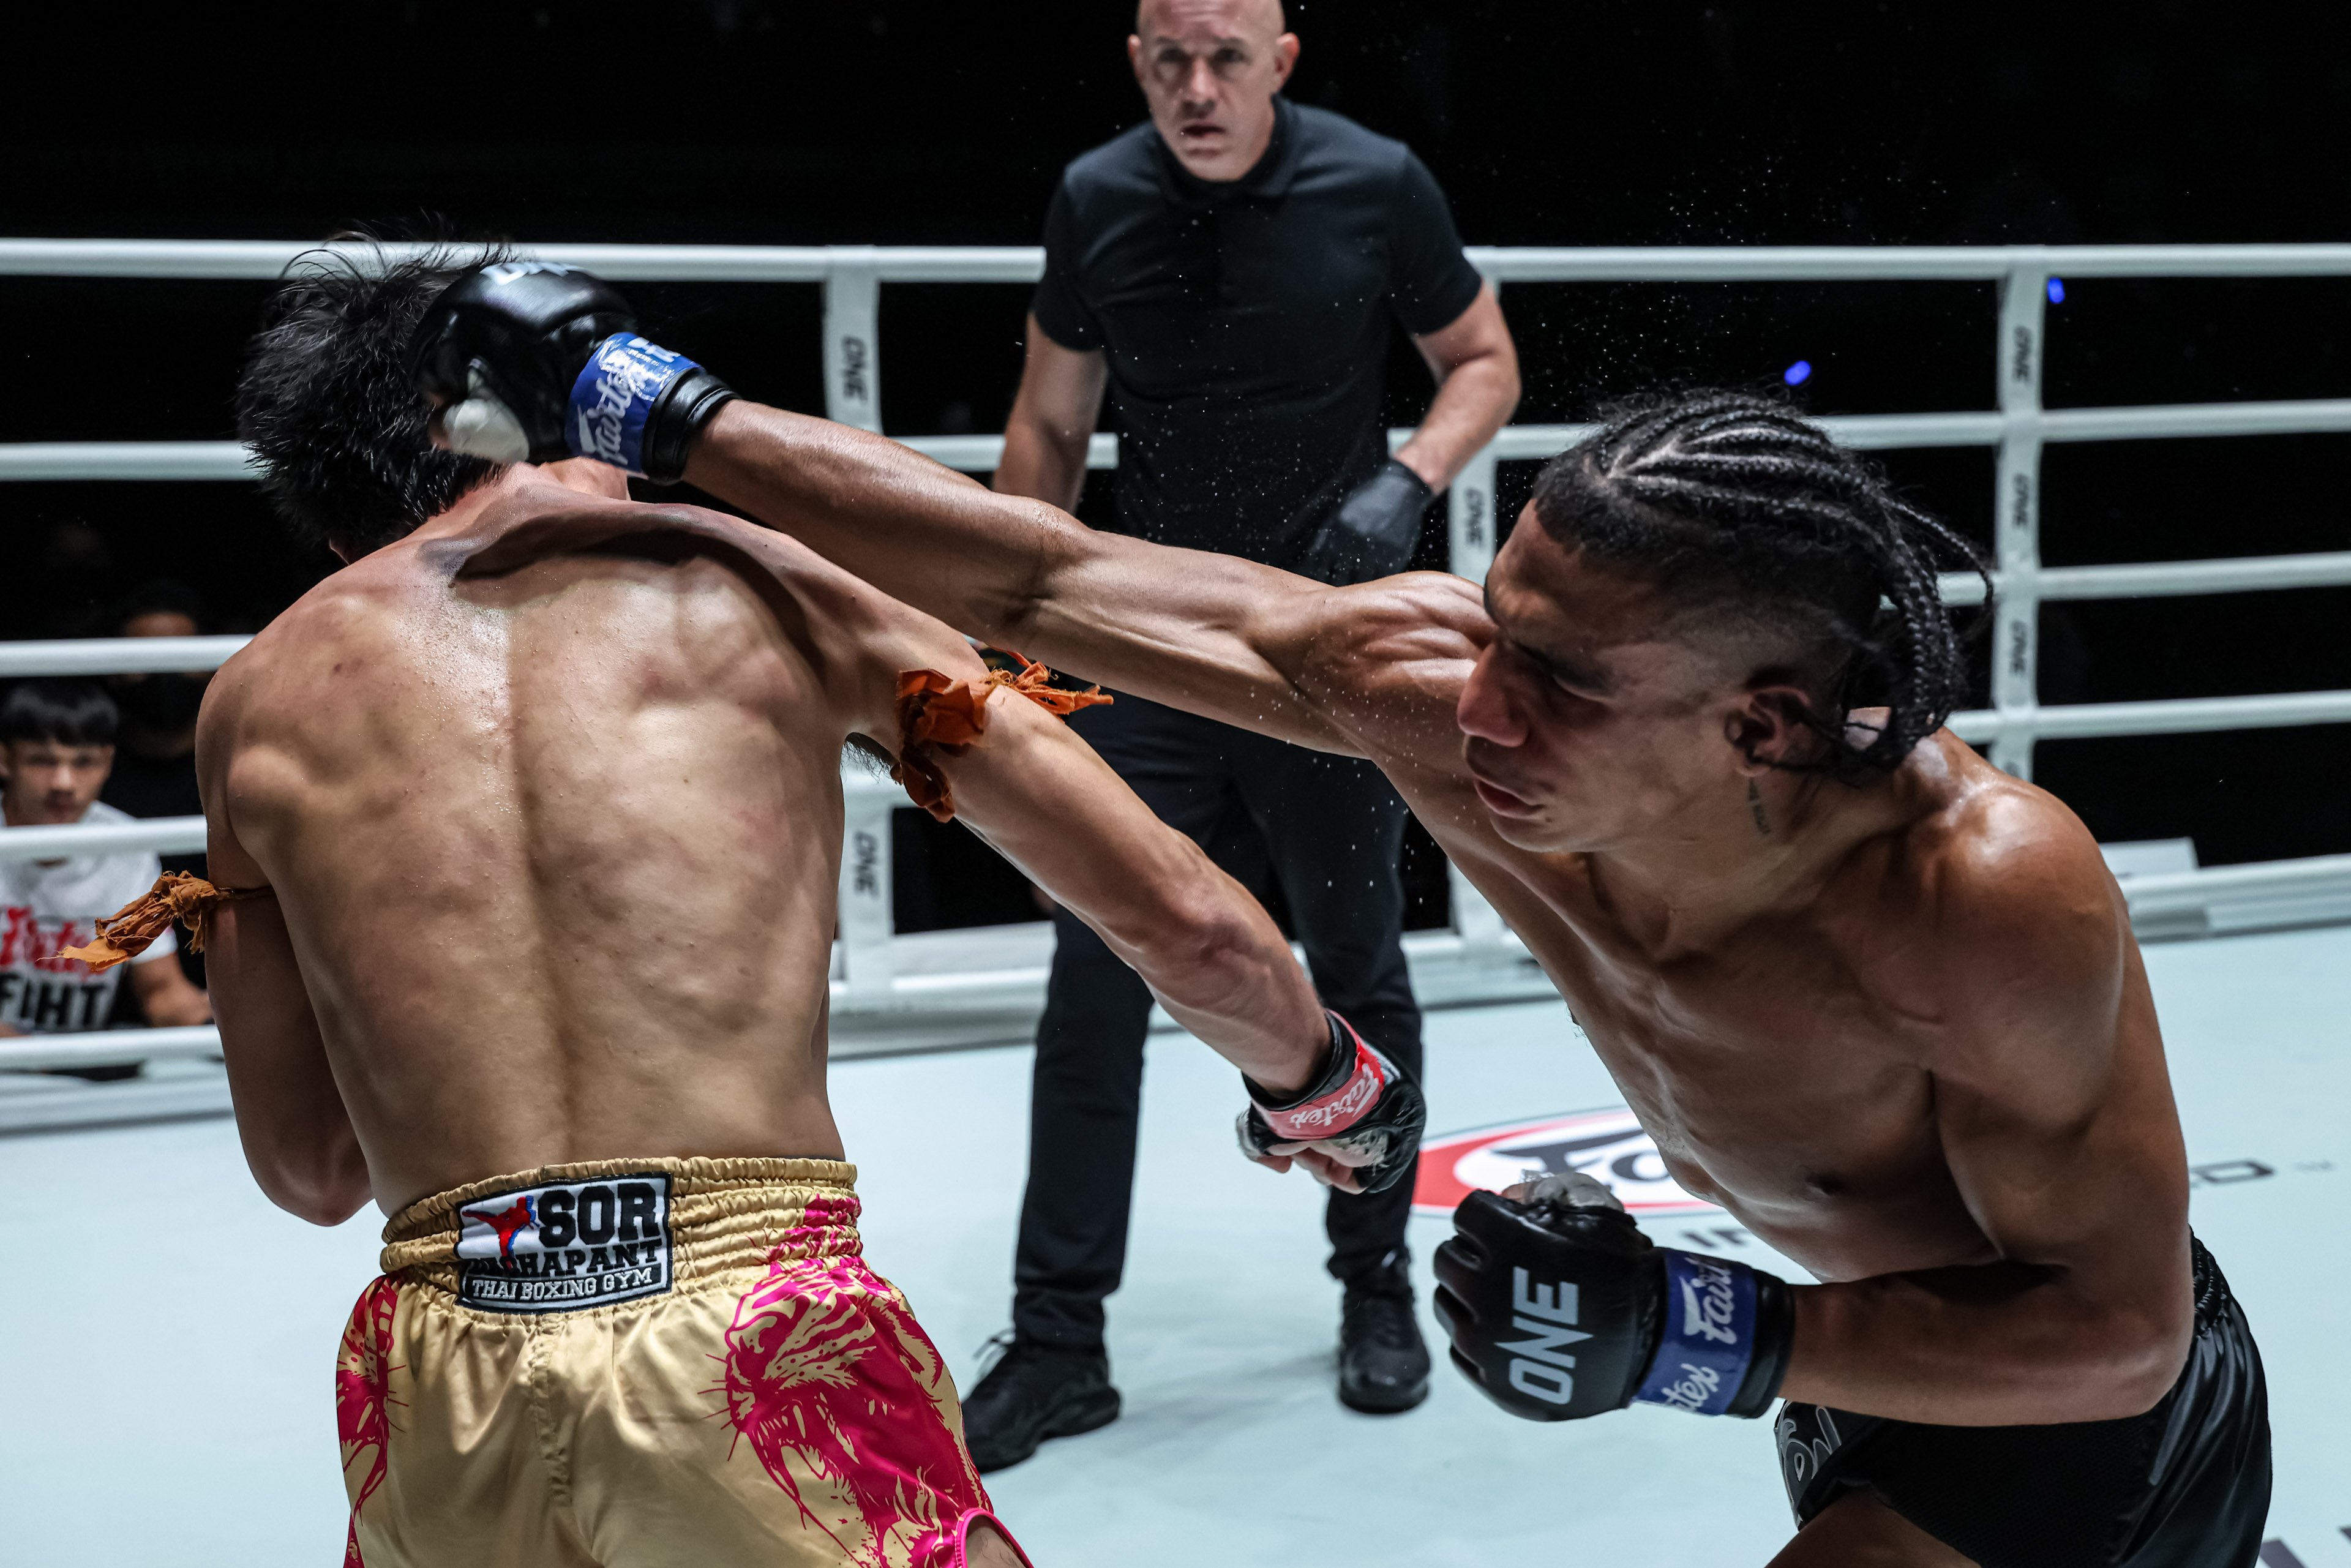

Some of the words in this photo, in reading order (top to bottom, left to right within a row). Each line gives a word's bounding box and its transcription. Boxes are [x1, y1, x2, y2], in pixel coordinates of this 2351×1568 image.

[537, 1182, 661, 1248] SOR
[471, 1278, 519, 1300] THAI
[520, 1277, 598, 1302] BOXING
[602, 1267, 653, 1291] GYM
[1494, 1266, 1594, 1405] ONE
